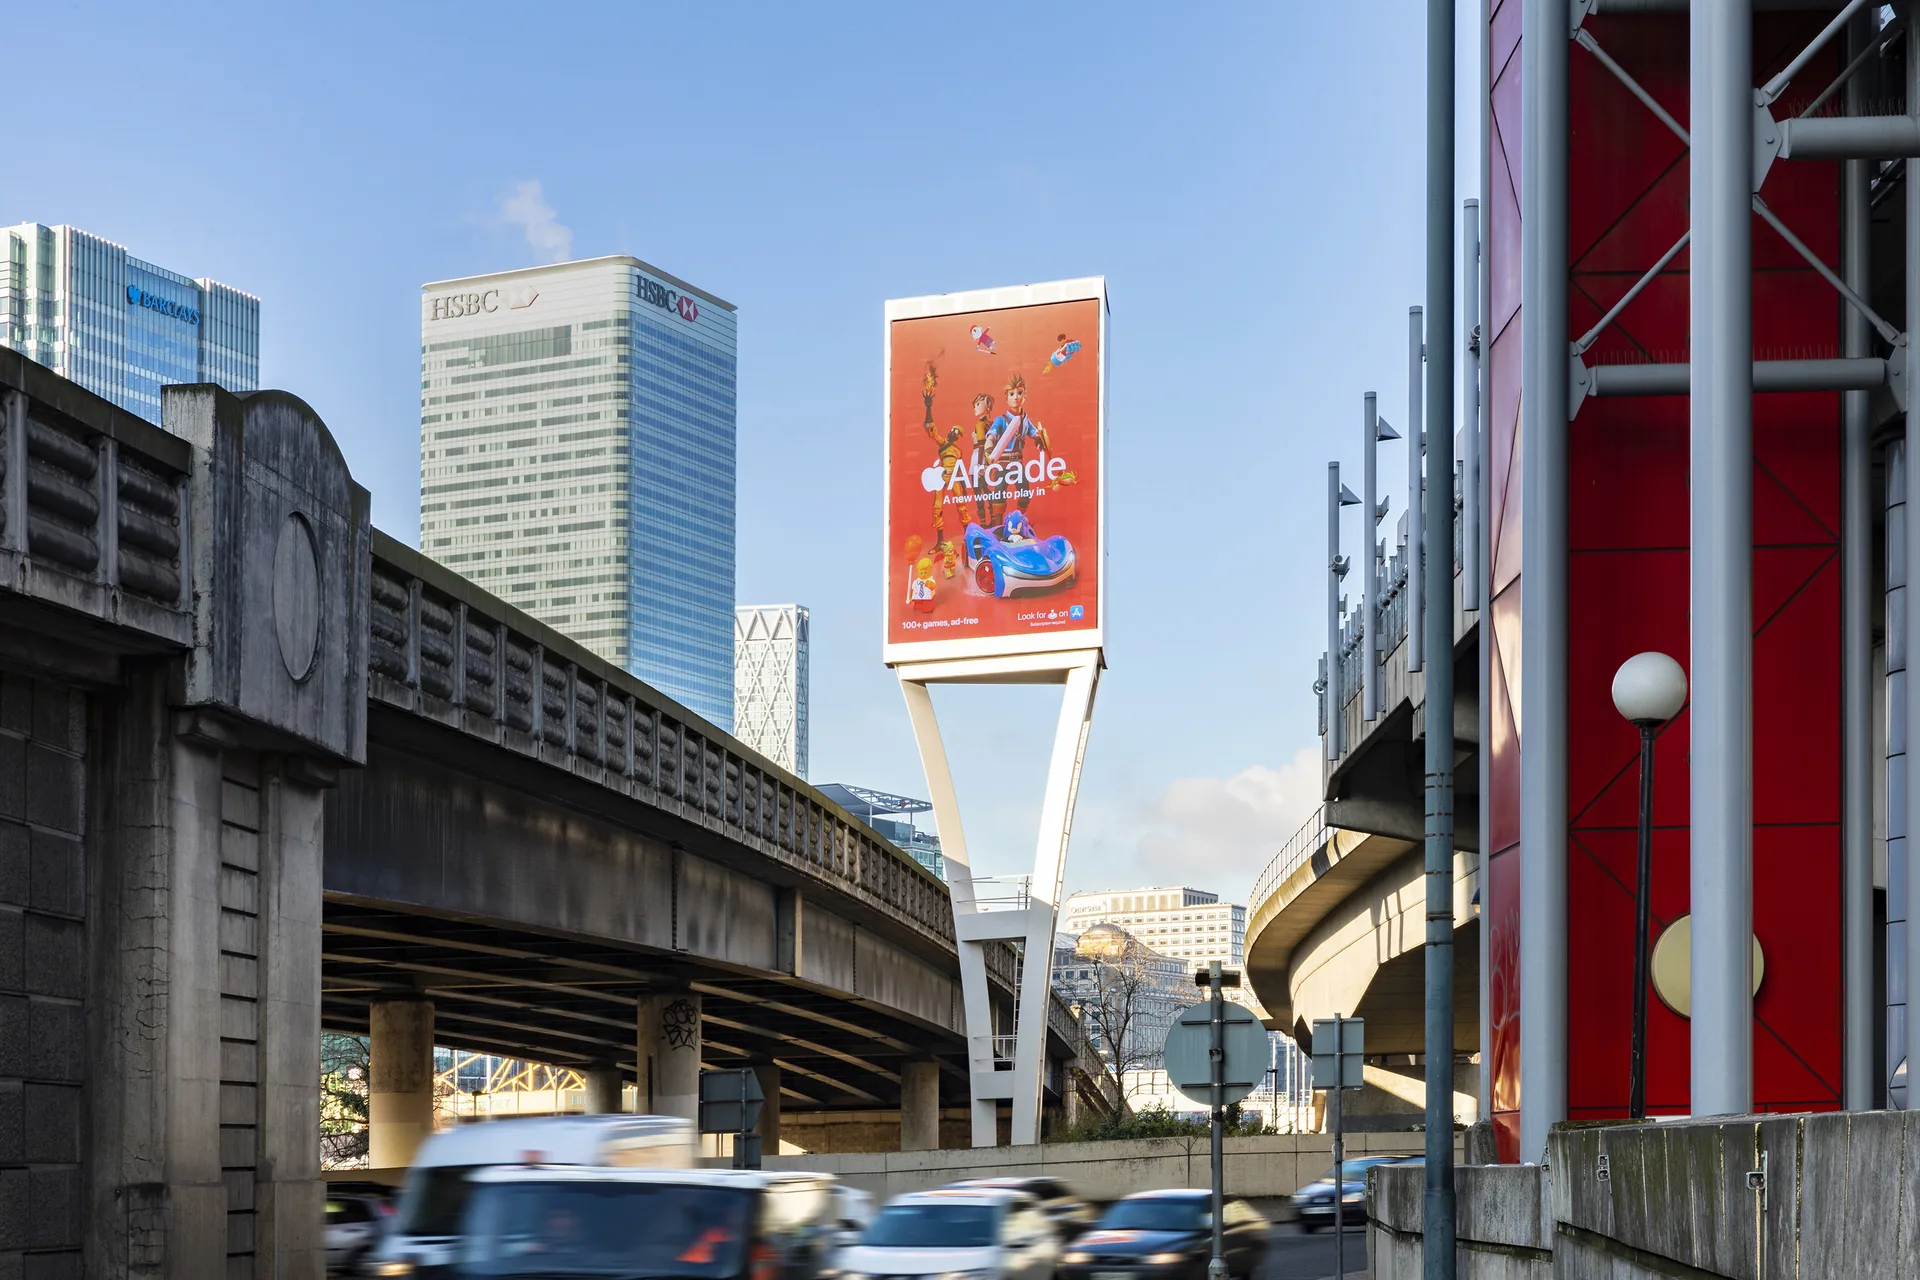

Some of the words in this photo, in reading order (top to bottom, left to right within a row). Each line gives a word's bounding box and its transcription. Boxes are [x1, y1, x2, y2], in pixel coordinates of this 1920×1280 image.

[142, 291, 200, 325] BARCLAYS
[431, 289, 499, 321] HSBC
[636, 274, 677, 313] HSBC
[947, 451, 1067, 490] Arcade
[943, 495, 951, 504] A
[952, 495, 973, 504] new
[973, 491, 1001, 502] world
[1002, 490, 1013, 499] to
[1014, 488, 1033, 500] play
[1036, 486, 1046, 496] in
[902, 621, 921, 629] 100+
[923, 620, 950, 629] games,
[951, 617, 979, 626] ad-free
[1017, 612, 1035, 620] Look
[1036, 611, 1046, 619] for
